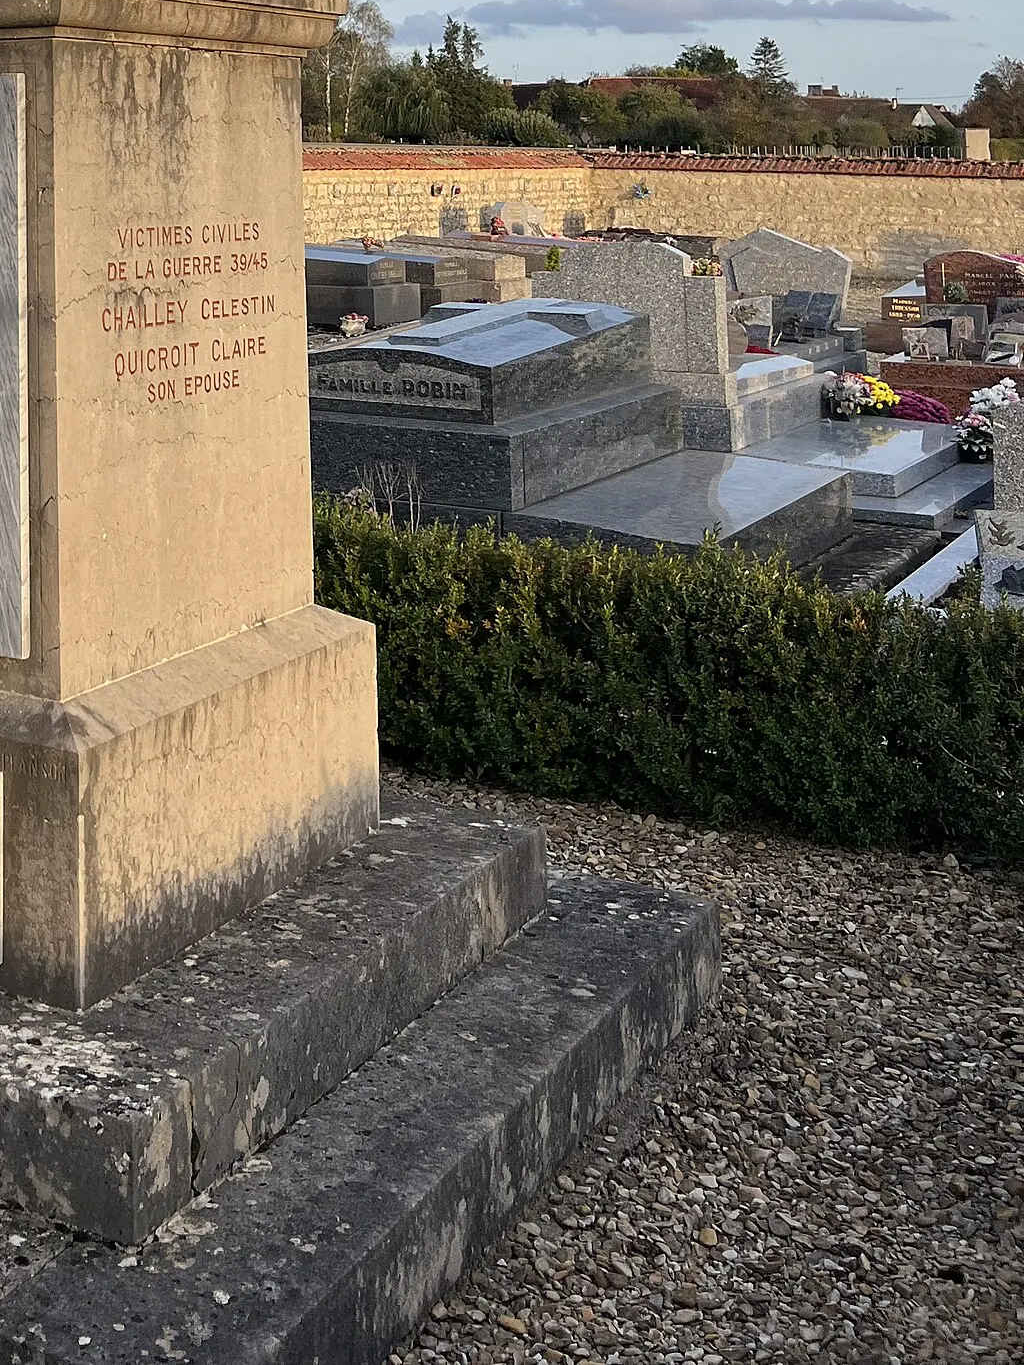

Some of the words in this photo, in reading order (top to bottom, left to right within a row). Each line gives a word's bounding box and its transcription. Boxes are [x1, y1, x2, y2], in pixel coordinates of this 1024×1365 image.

[117, 225, 193, 248] VICTIMES
[201, 222, 260, 244] CIVILES
[107, 262, 127, 281] DE
[135, 259, 155, 280] LA
[163, 255, 222, 279] GUERRE
[230, 252, 268, 272] 39/45
[101, 300, 188, 332] CHAILLEY
[201, 295, 275, 320] CELESTIN
[114, 342, 199, 381] QUICROIT
[212, 336, 266, 362] CLAIRE
[147, 380, 176, 403] SON
[184, 369, 240, 396] EPOUSE
[317, 373, 394, 396] FAMILLE
[402, 378, 470, 400] ROBIN
